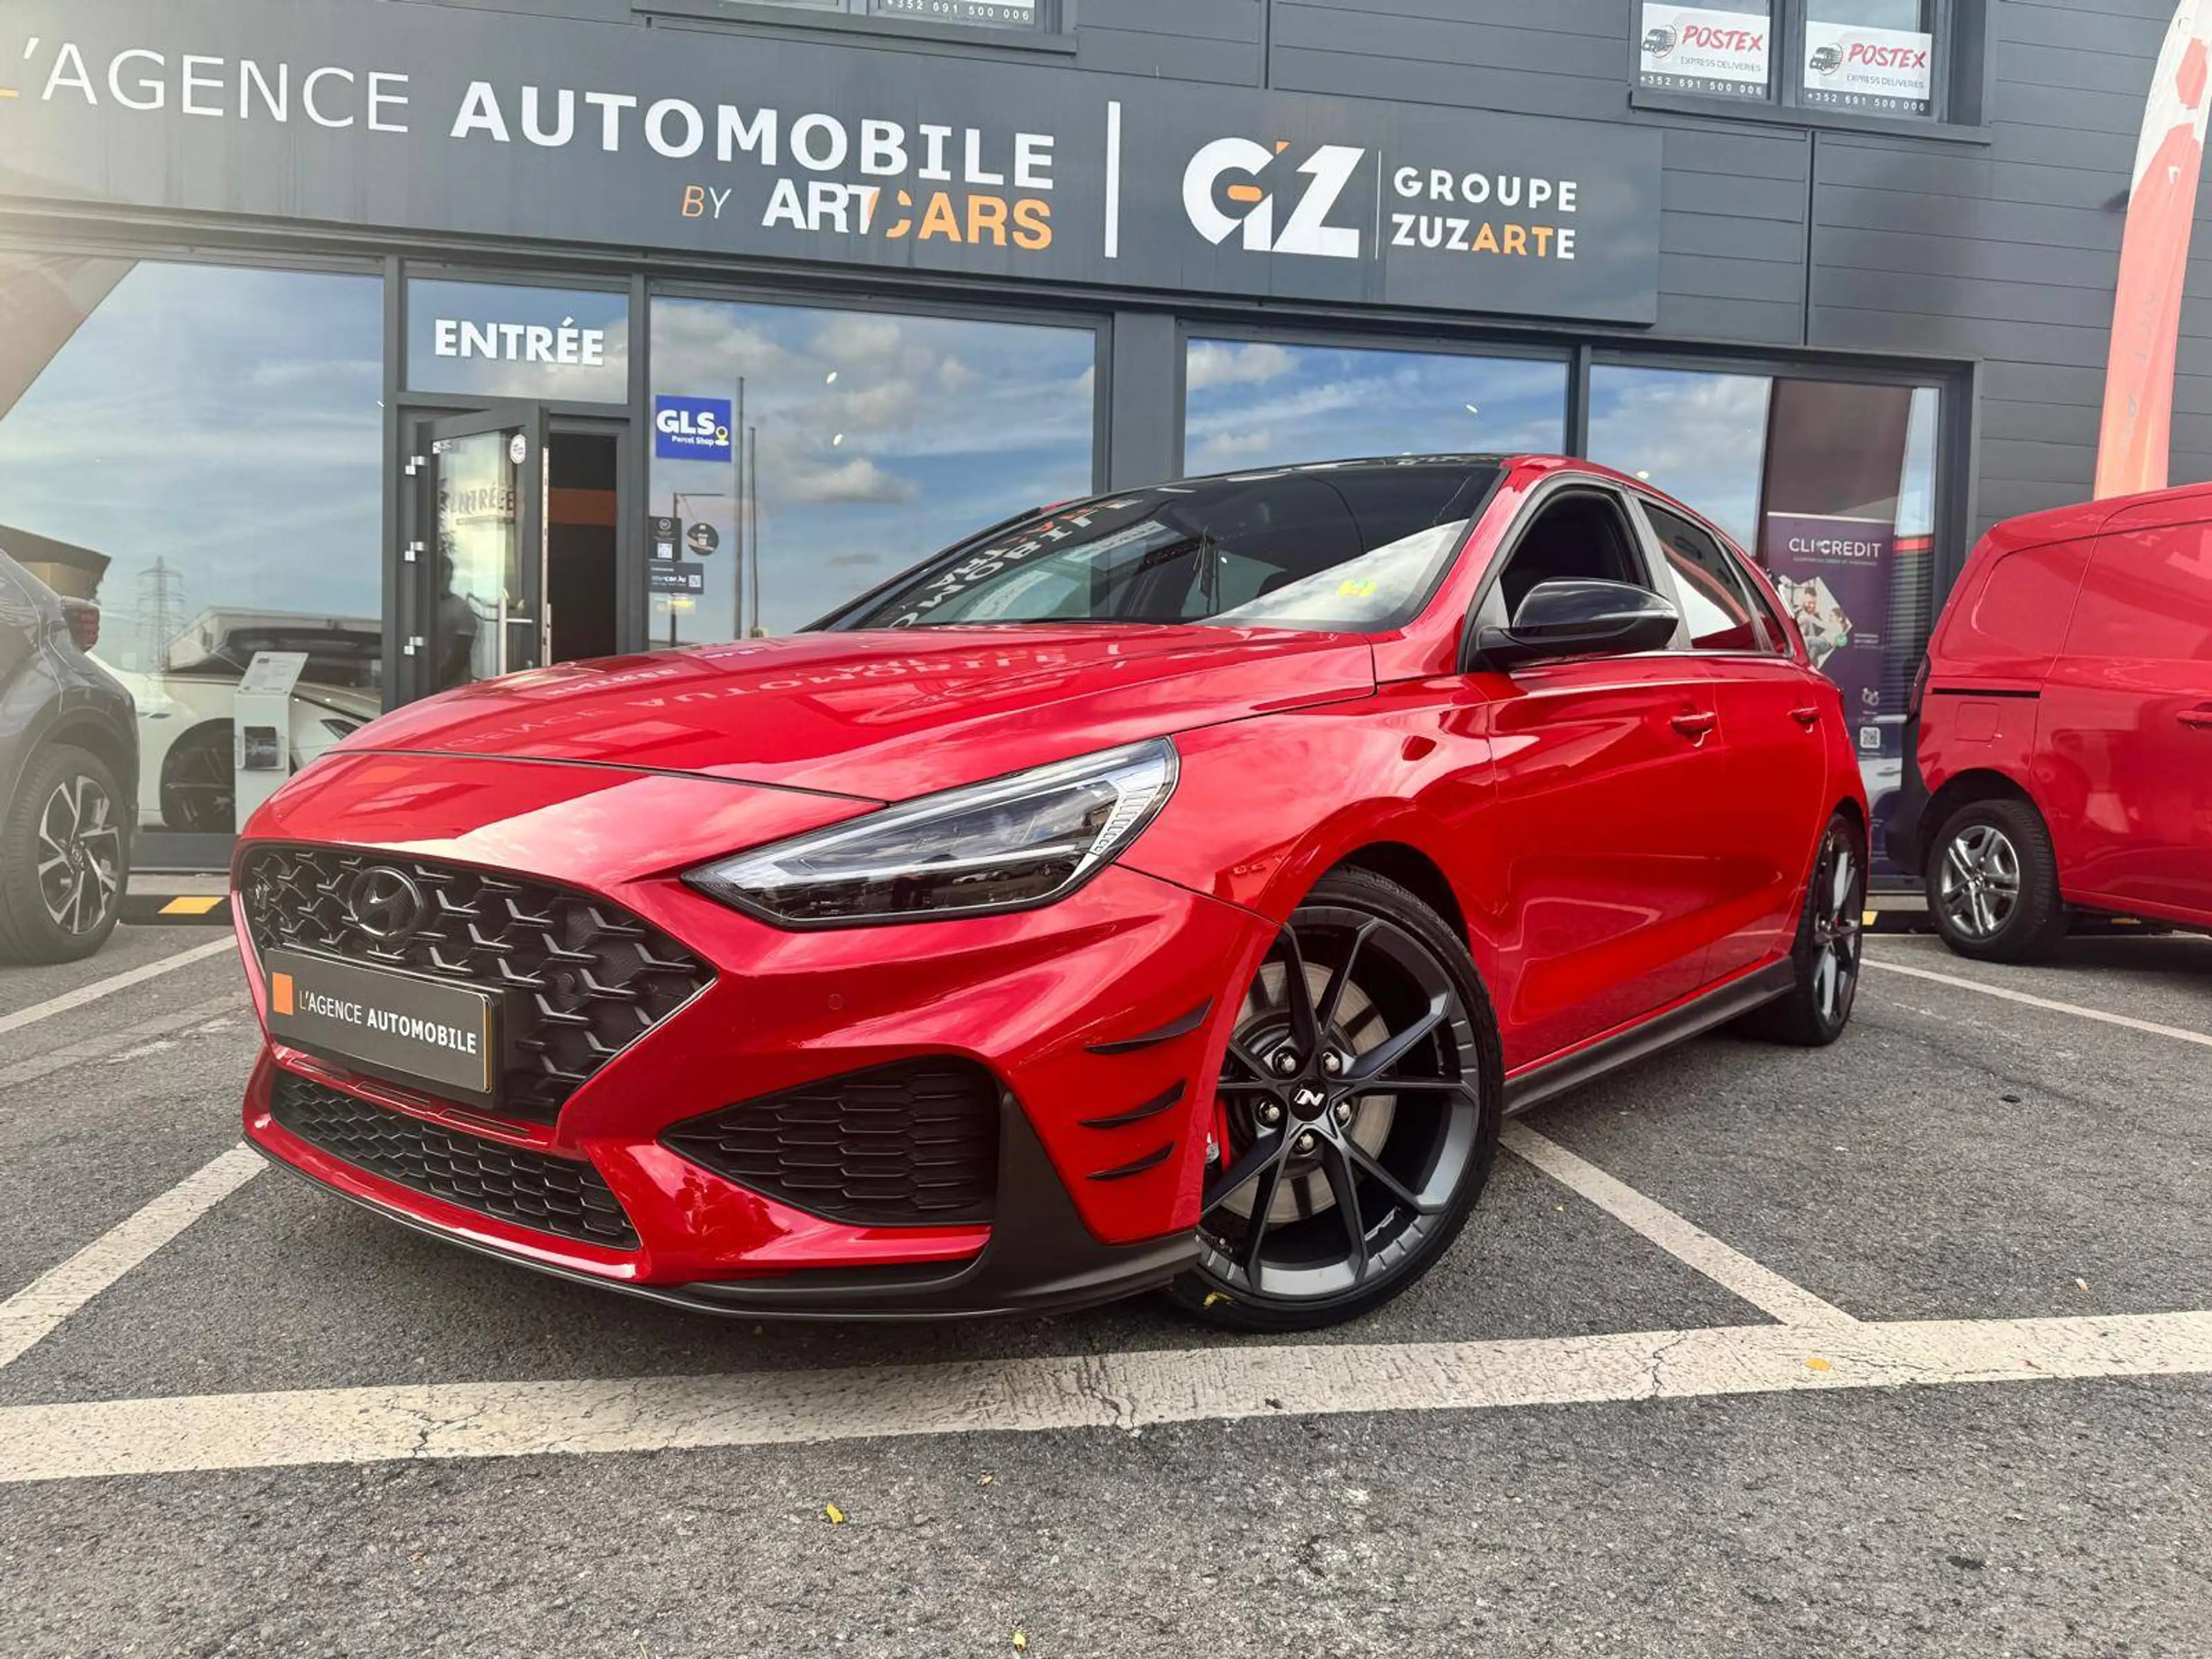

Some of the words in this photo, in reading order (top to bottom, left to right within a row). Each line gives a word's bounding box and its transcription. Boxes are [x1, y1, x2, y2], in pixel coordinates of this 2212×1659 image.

[933, 2, 957, 12] 691
[969, 6, 994, 17] 500
[1002, 9, 1029, 20] 006
[1681, 25, 1763, 52] POSTEX
[1680, 56, 1715, 67] EXPRESS
[1717, 59, 1762, 72] DELIVERIES
[1847, 43, 1926, 69] POSTEX
[1640, 76, 1671, 86] +352
[1679, 79, 1700, 89] 691
[1710, 81, 1732, 92] 500
[1739, 84, 1763, 95] 006
[1846, 74, 1880, 84] EXPRESS
[1881, 77, 1925, 89] DELIVERIES
[1808, 92, 1837, 103] +352
[1845, 95, 1866, 105] 691
[1874, 99, 1896, 108] 500
[1903, 101, 1925, 111] 006
[449, 81, 1055, 190] AUTOMOBILE
[681, 184, 732, 219] BY
[1393, 166, 1578, 212] GROUPE
[1391, 212, 1576, 260] ZUZARTE
[434, 316, 604, 366] ENTRÉE
[656, 409, 715, 435] GLS
[672, 435, 695, 445] Parcel
[695, 436, 714, 448] Shop
[299, 990, 362, 1024] L'AGENCE
[366, 1008, 477, 1054] AUTOMOBILE
